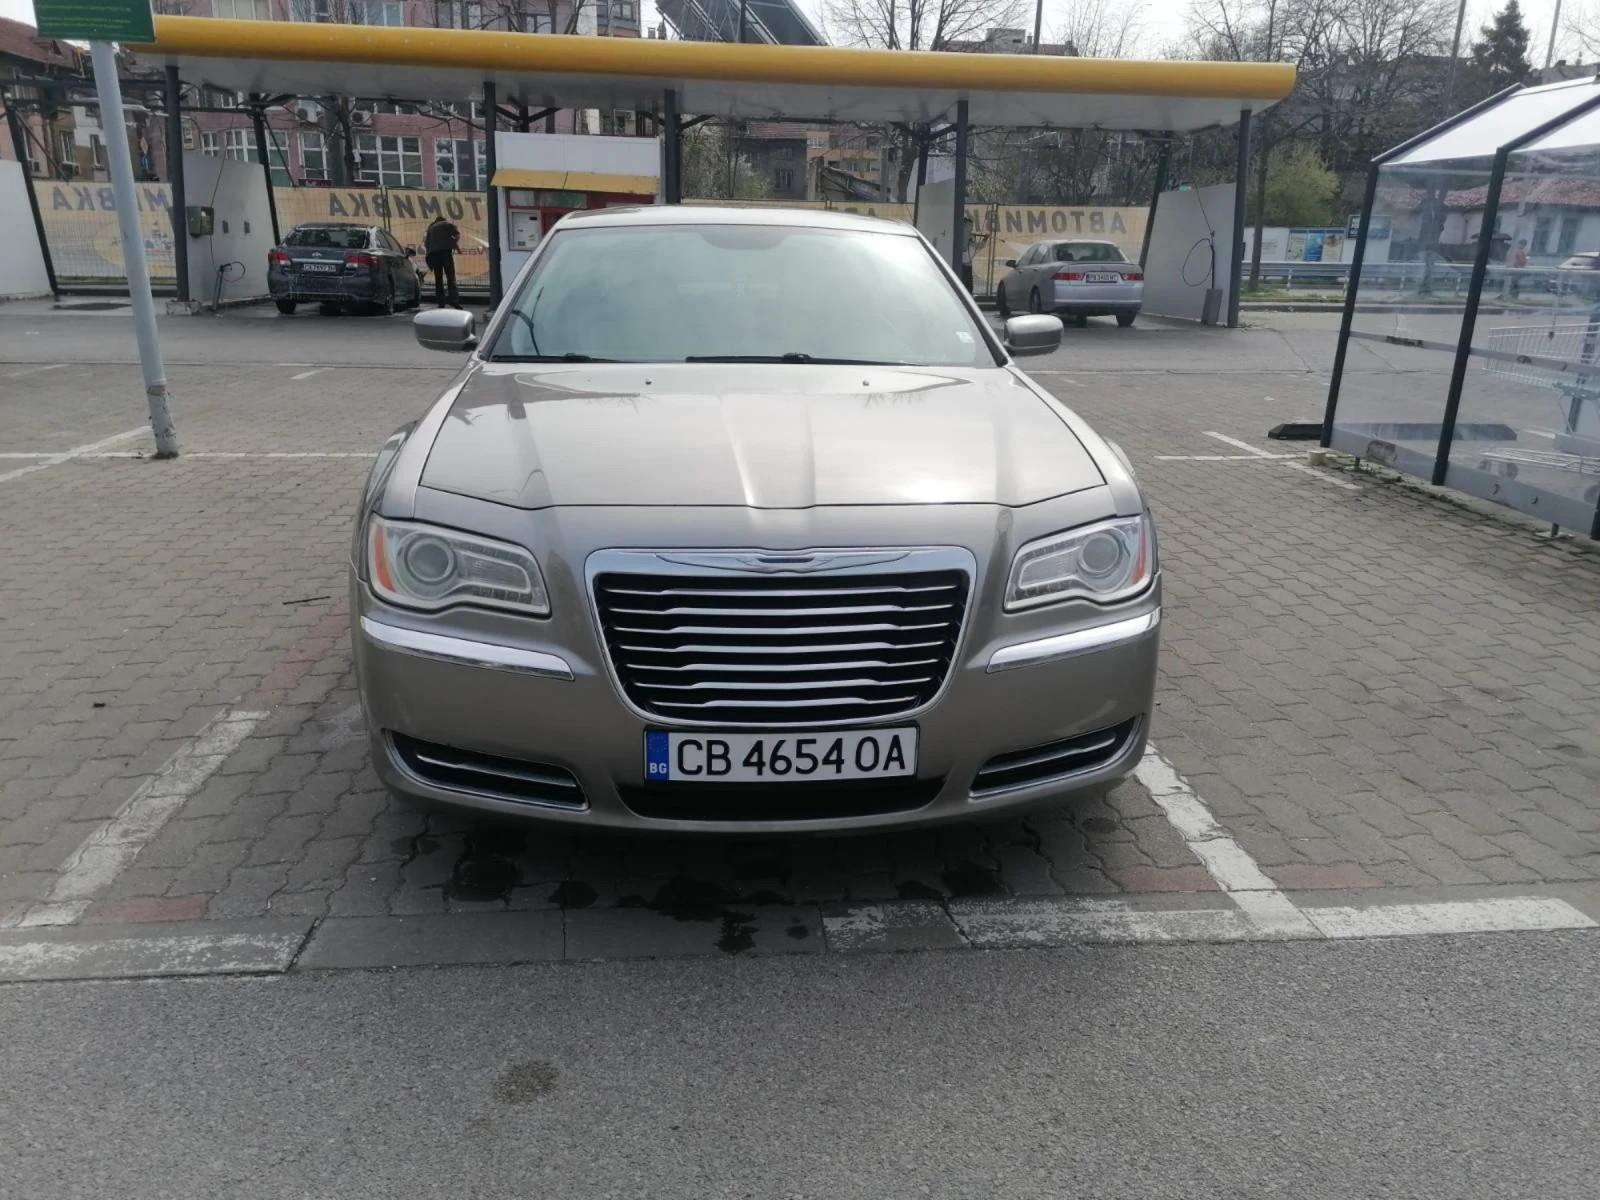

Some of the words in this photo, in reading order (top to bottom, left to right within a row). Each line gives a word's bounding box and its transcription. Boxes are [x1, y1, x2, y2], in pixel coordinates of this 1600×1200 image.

[650, 762, 667, 774] BG
[677, 739, 732, 776] CB
[742, 737, 845, 776] 4654
[855, 734, 906, 772] OA
